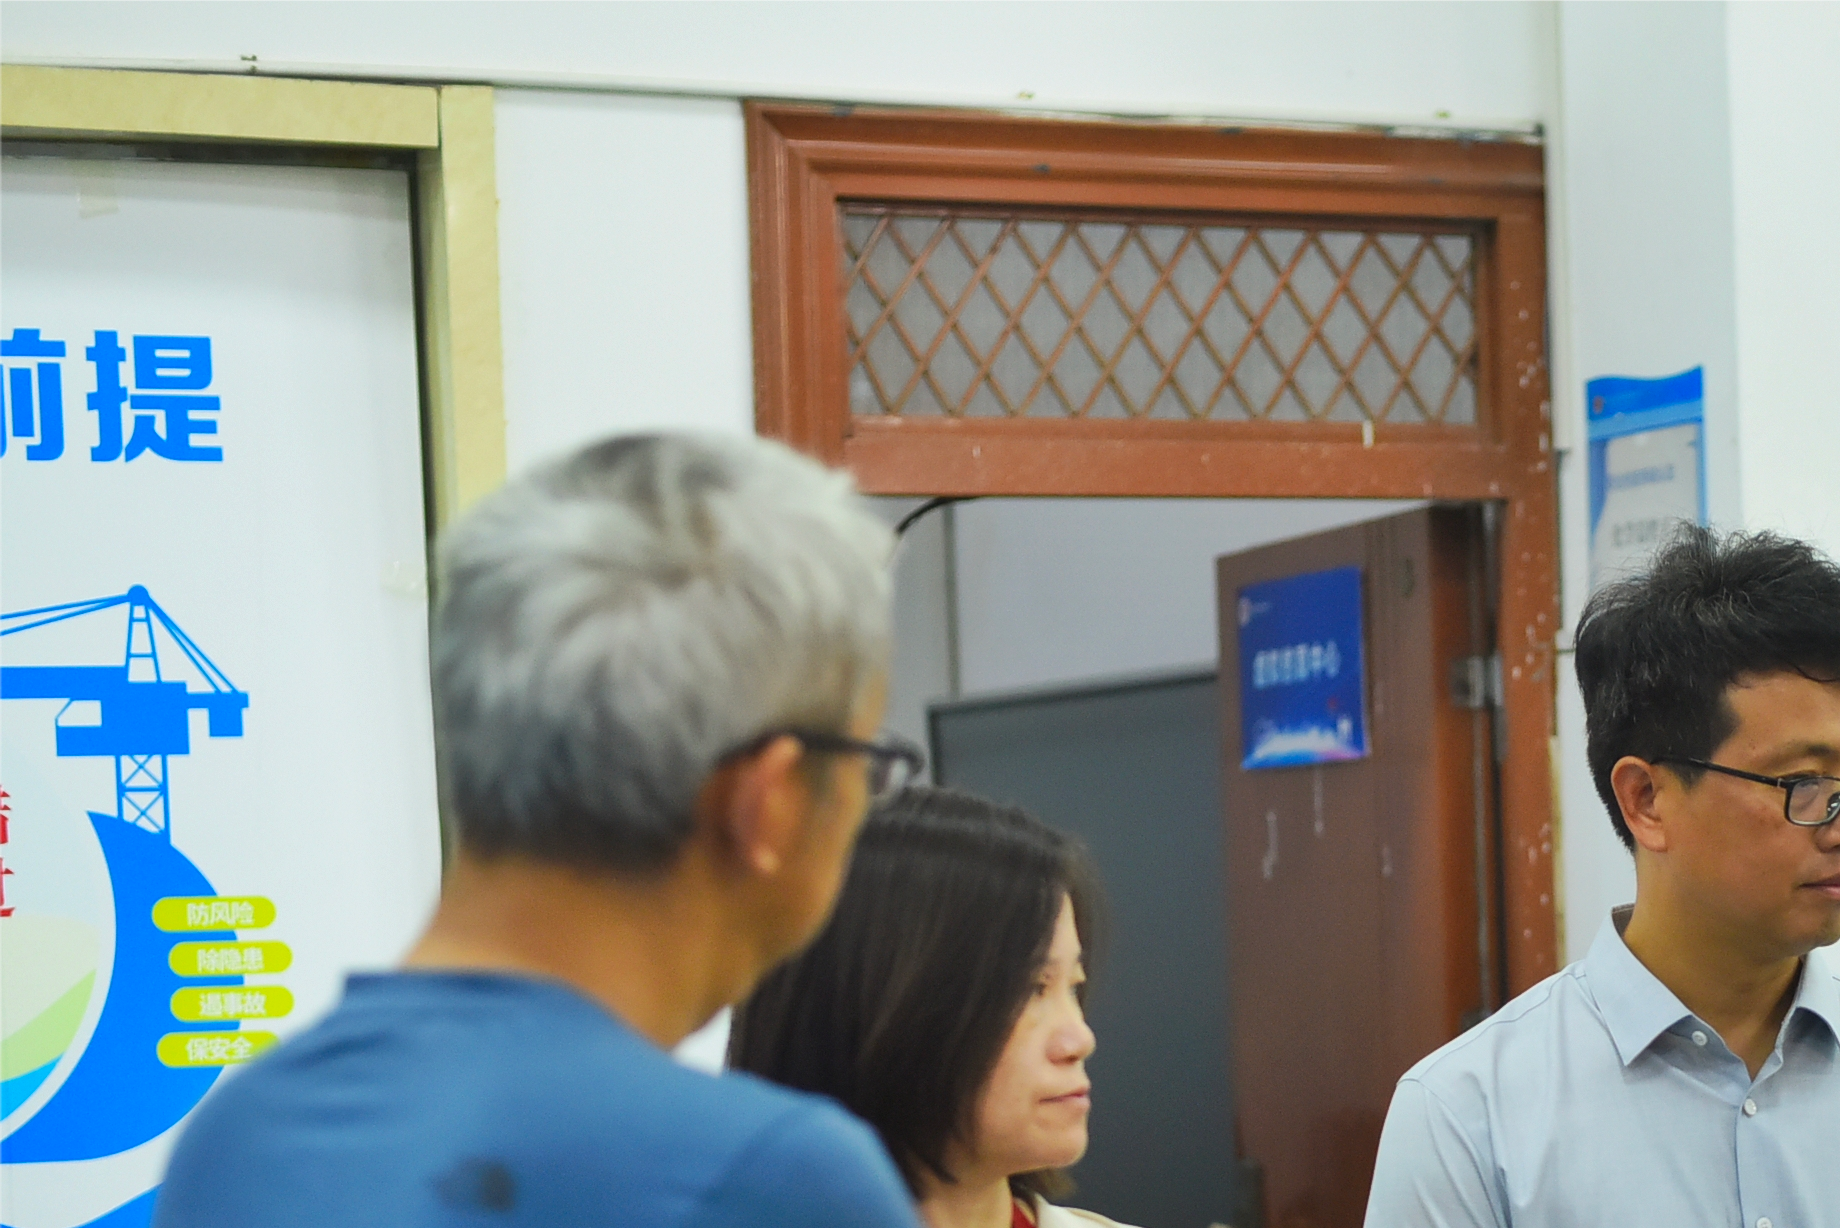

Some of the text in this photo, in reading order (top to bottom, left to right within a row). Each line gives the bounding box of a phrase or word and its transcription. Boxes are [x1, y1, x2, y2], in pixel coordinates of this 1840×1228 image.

[187, 902, 254, 927] 防风险
[197, 947, 264, 972] 除隐患
[186, 1036, 253, 1062] 保安全
